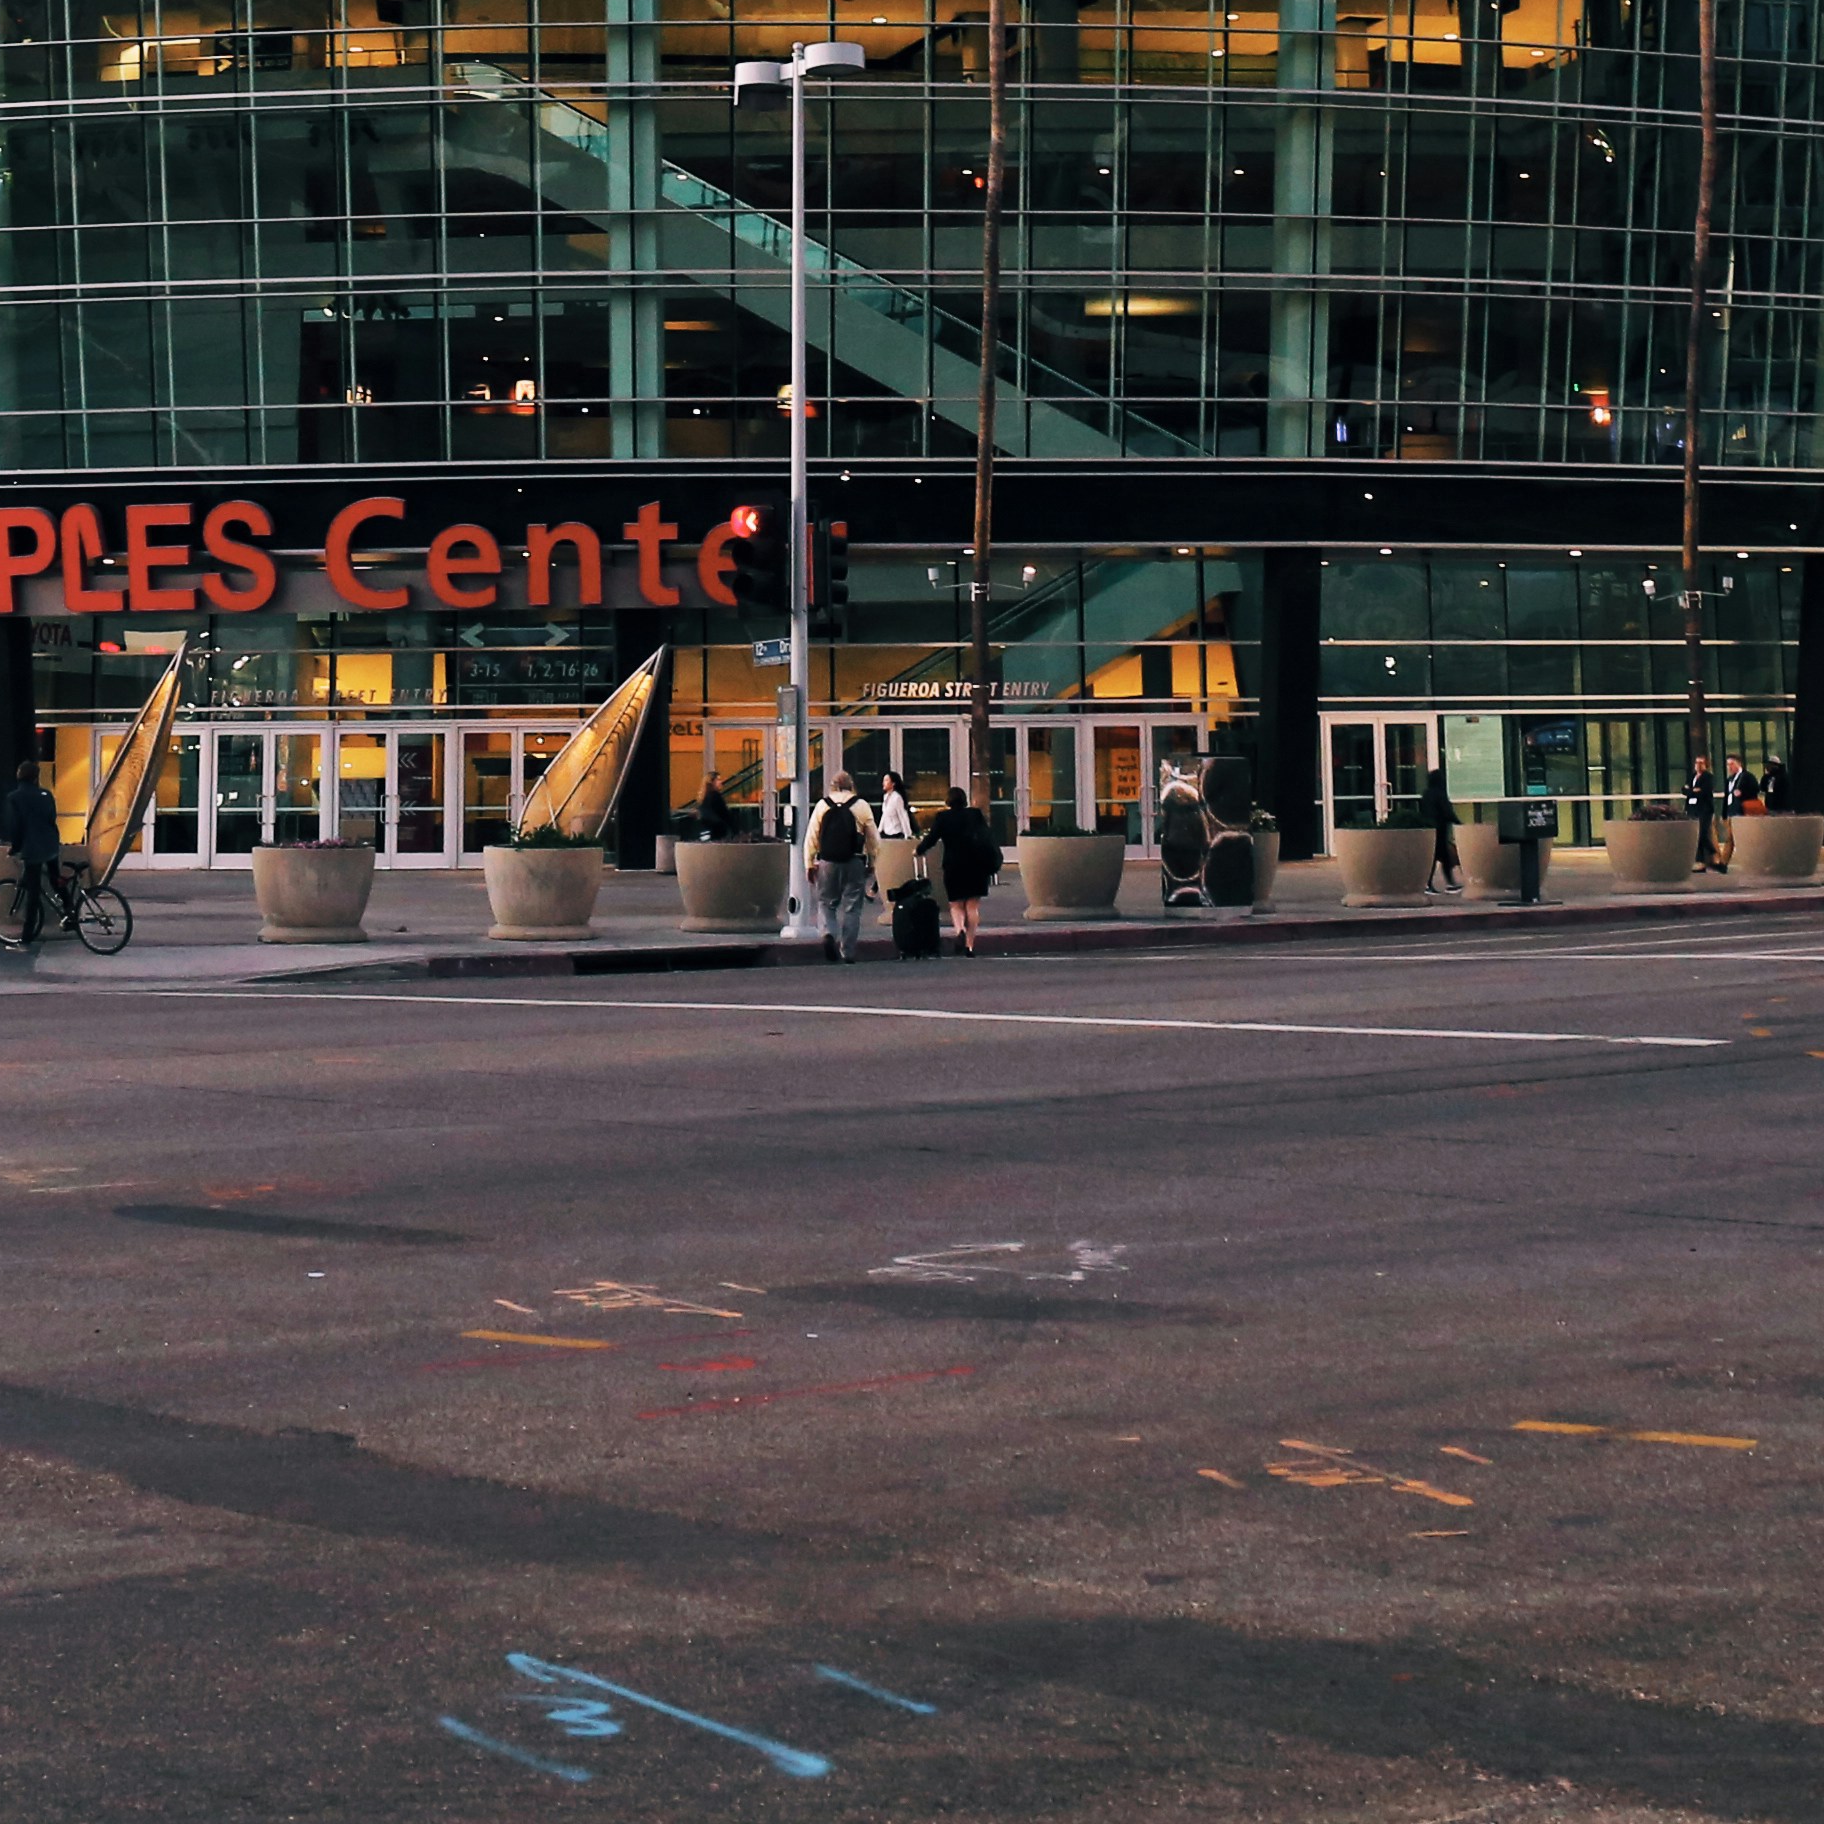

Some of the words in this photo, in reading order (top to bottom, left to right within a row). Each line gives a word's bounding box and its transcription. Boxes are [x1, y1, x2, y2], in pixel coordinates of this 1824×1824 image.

[863, 682, 940, 698] FIGUEROA
[945, 682, 998, 697] STRT
[1003, 681, 1050, 696] ENTRY
